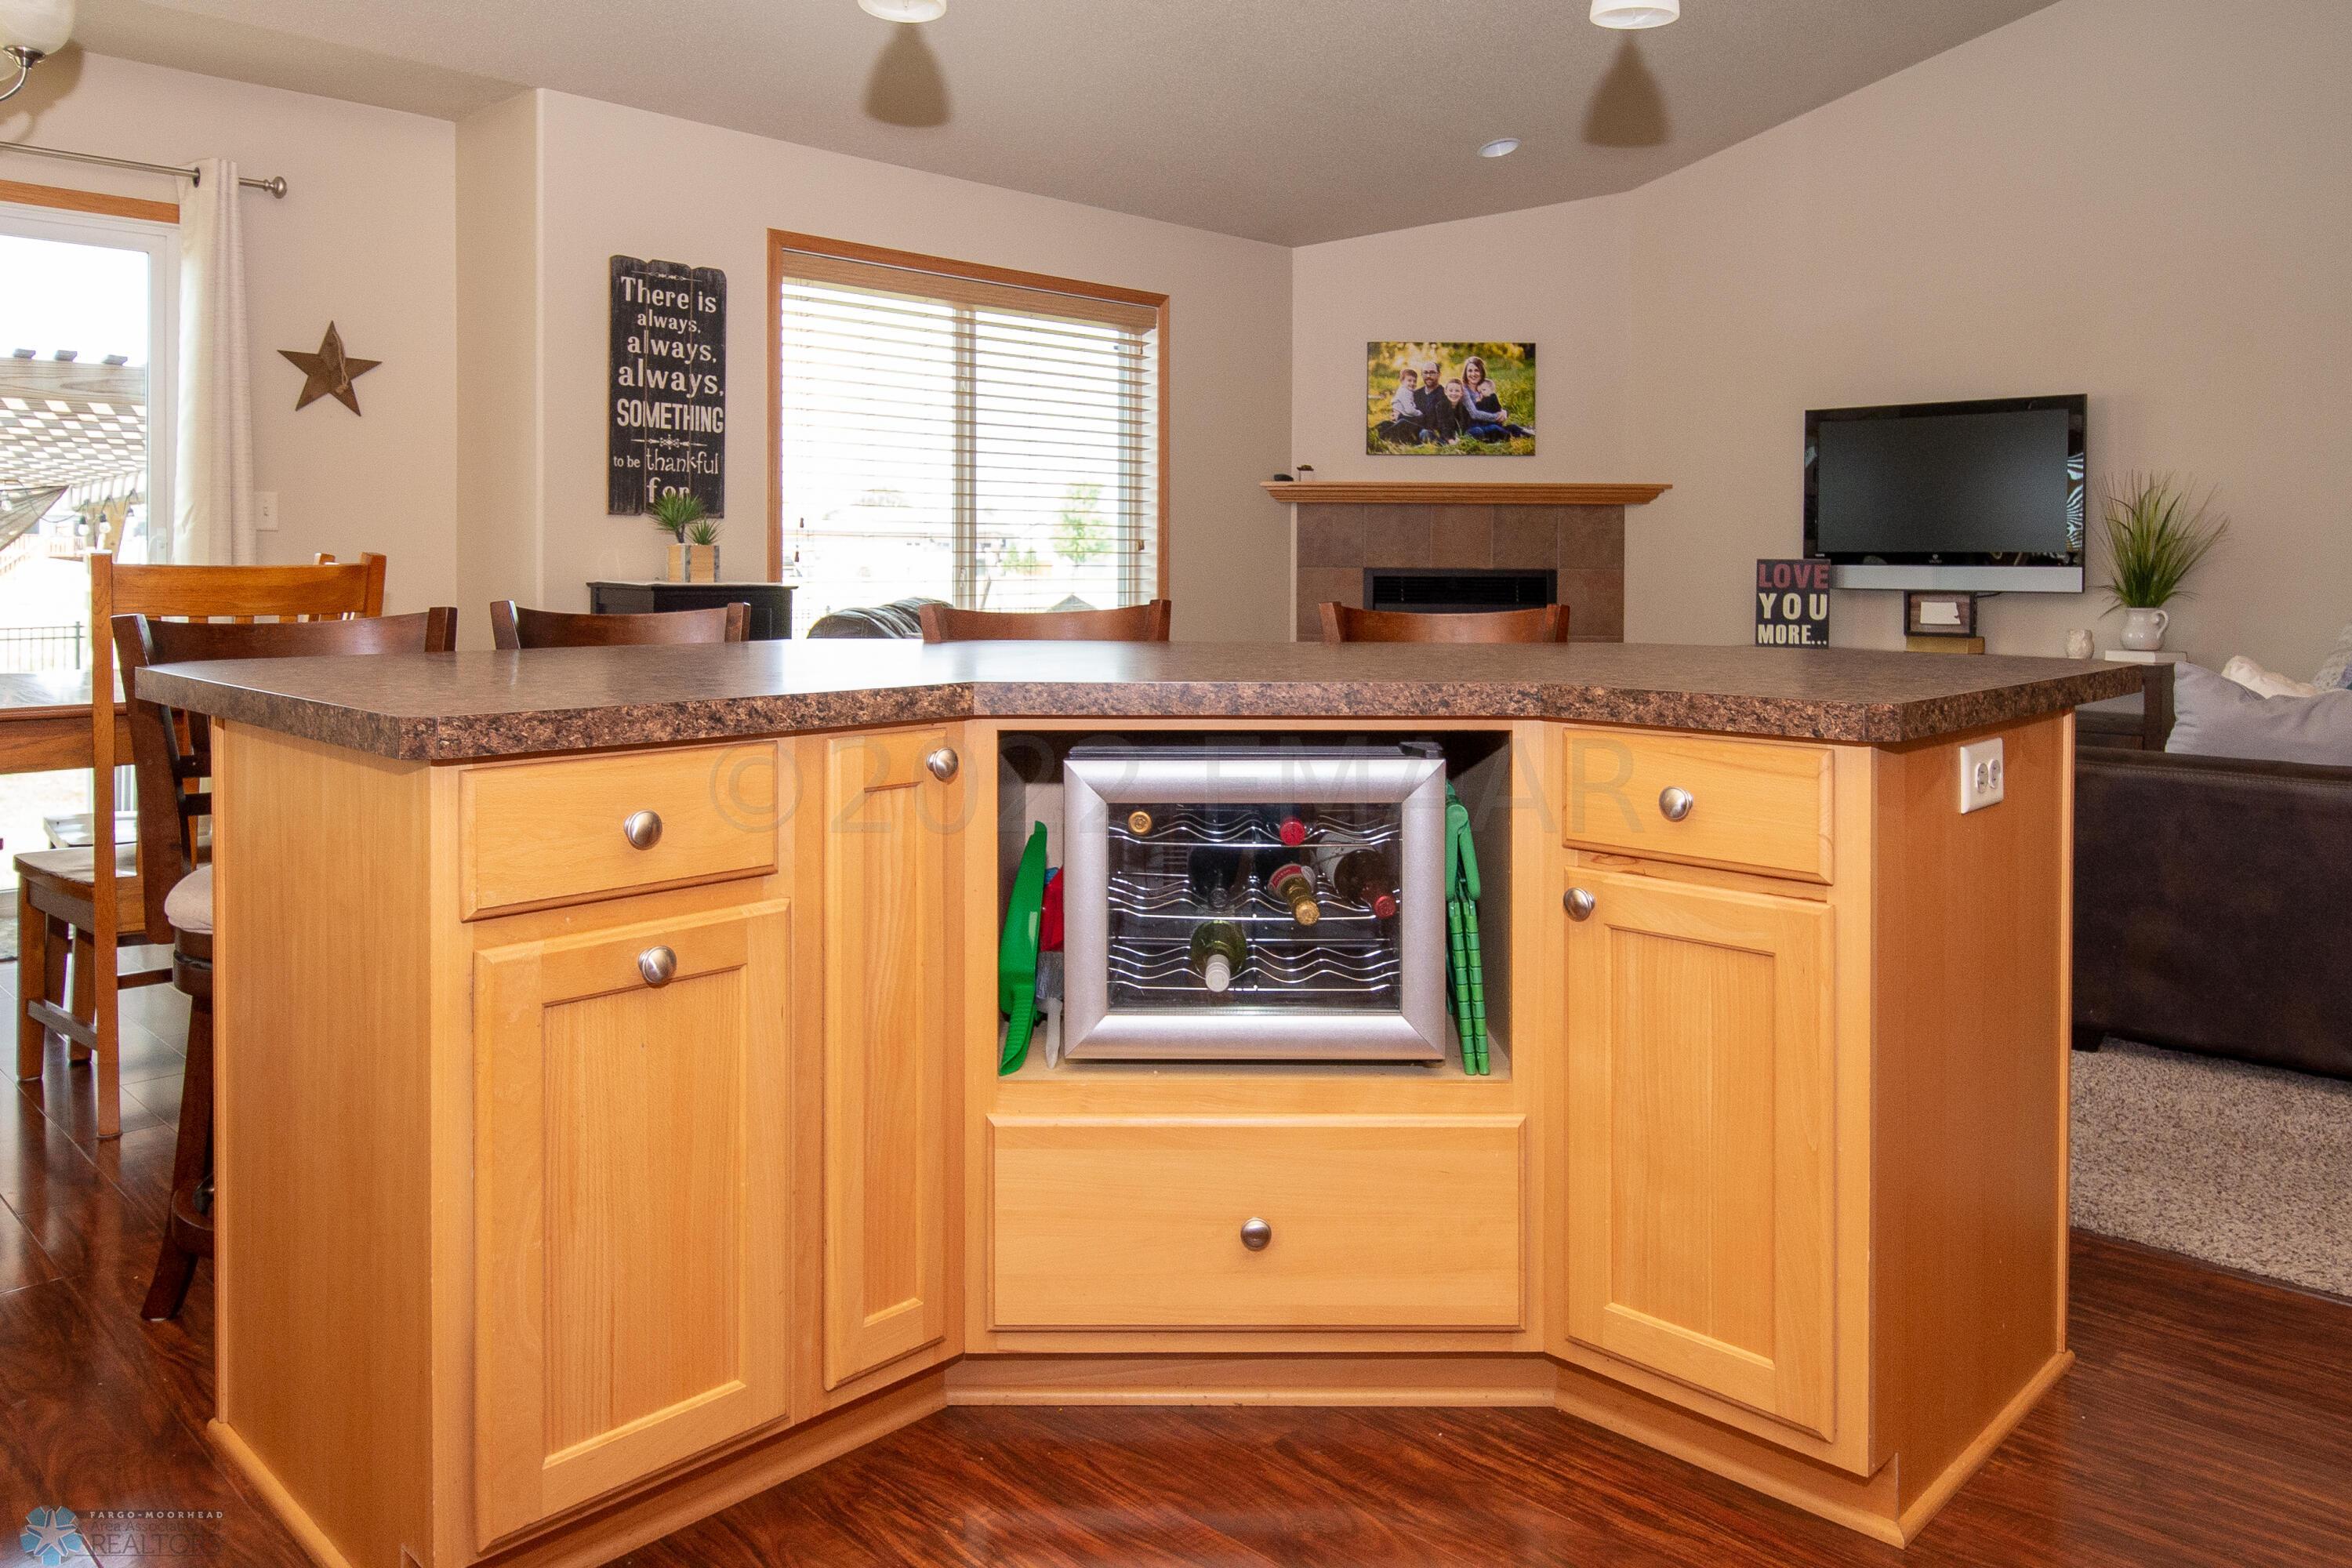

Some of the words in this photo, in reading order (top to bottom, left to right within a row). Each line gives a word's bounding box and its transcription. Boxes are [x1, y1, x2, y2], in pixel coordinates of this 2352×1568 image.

[620, 276, 689, 310] There
[699, 292, 717, 314] is
[637, 310, 702, 335] always,
[627, 329, 717, 365] always,
[618, 358, 724, 398] always,
[616, 398, 724, 434] SOMETHING
[613, 455, 624, 467] to
[626, 455, 641, 468] be
[645, 448, 719, 474] thankful
[1758, 563, 1831, 589] LOVE
[1758, 592, 1828, 621] YOU
[1757, 623, 1828, 645] MORE...
